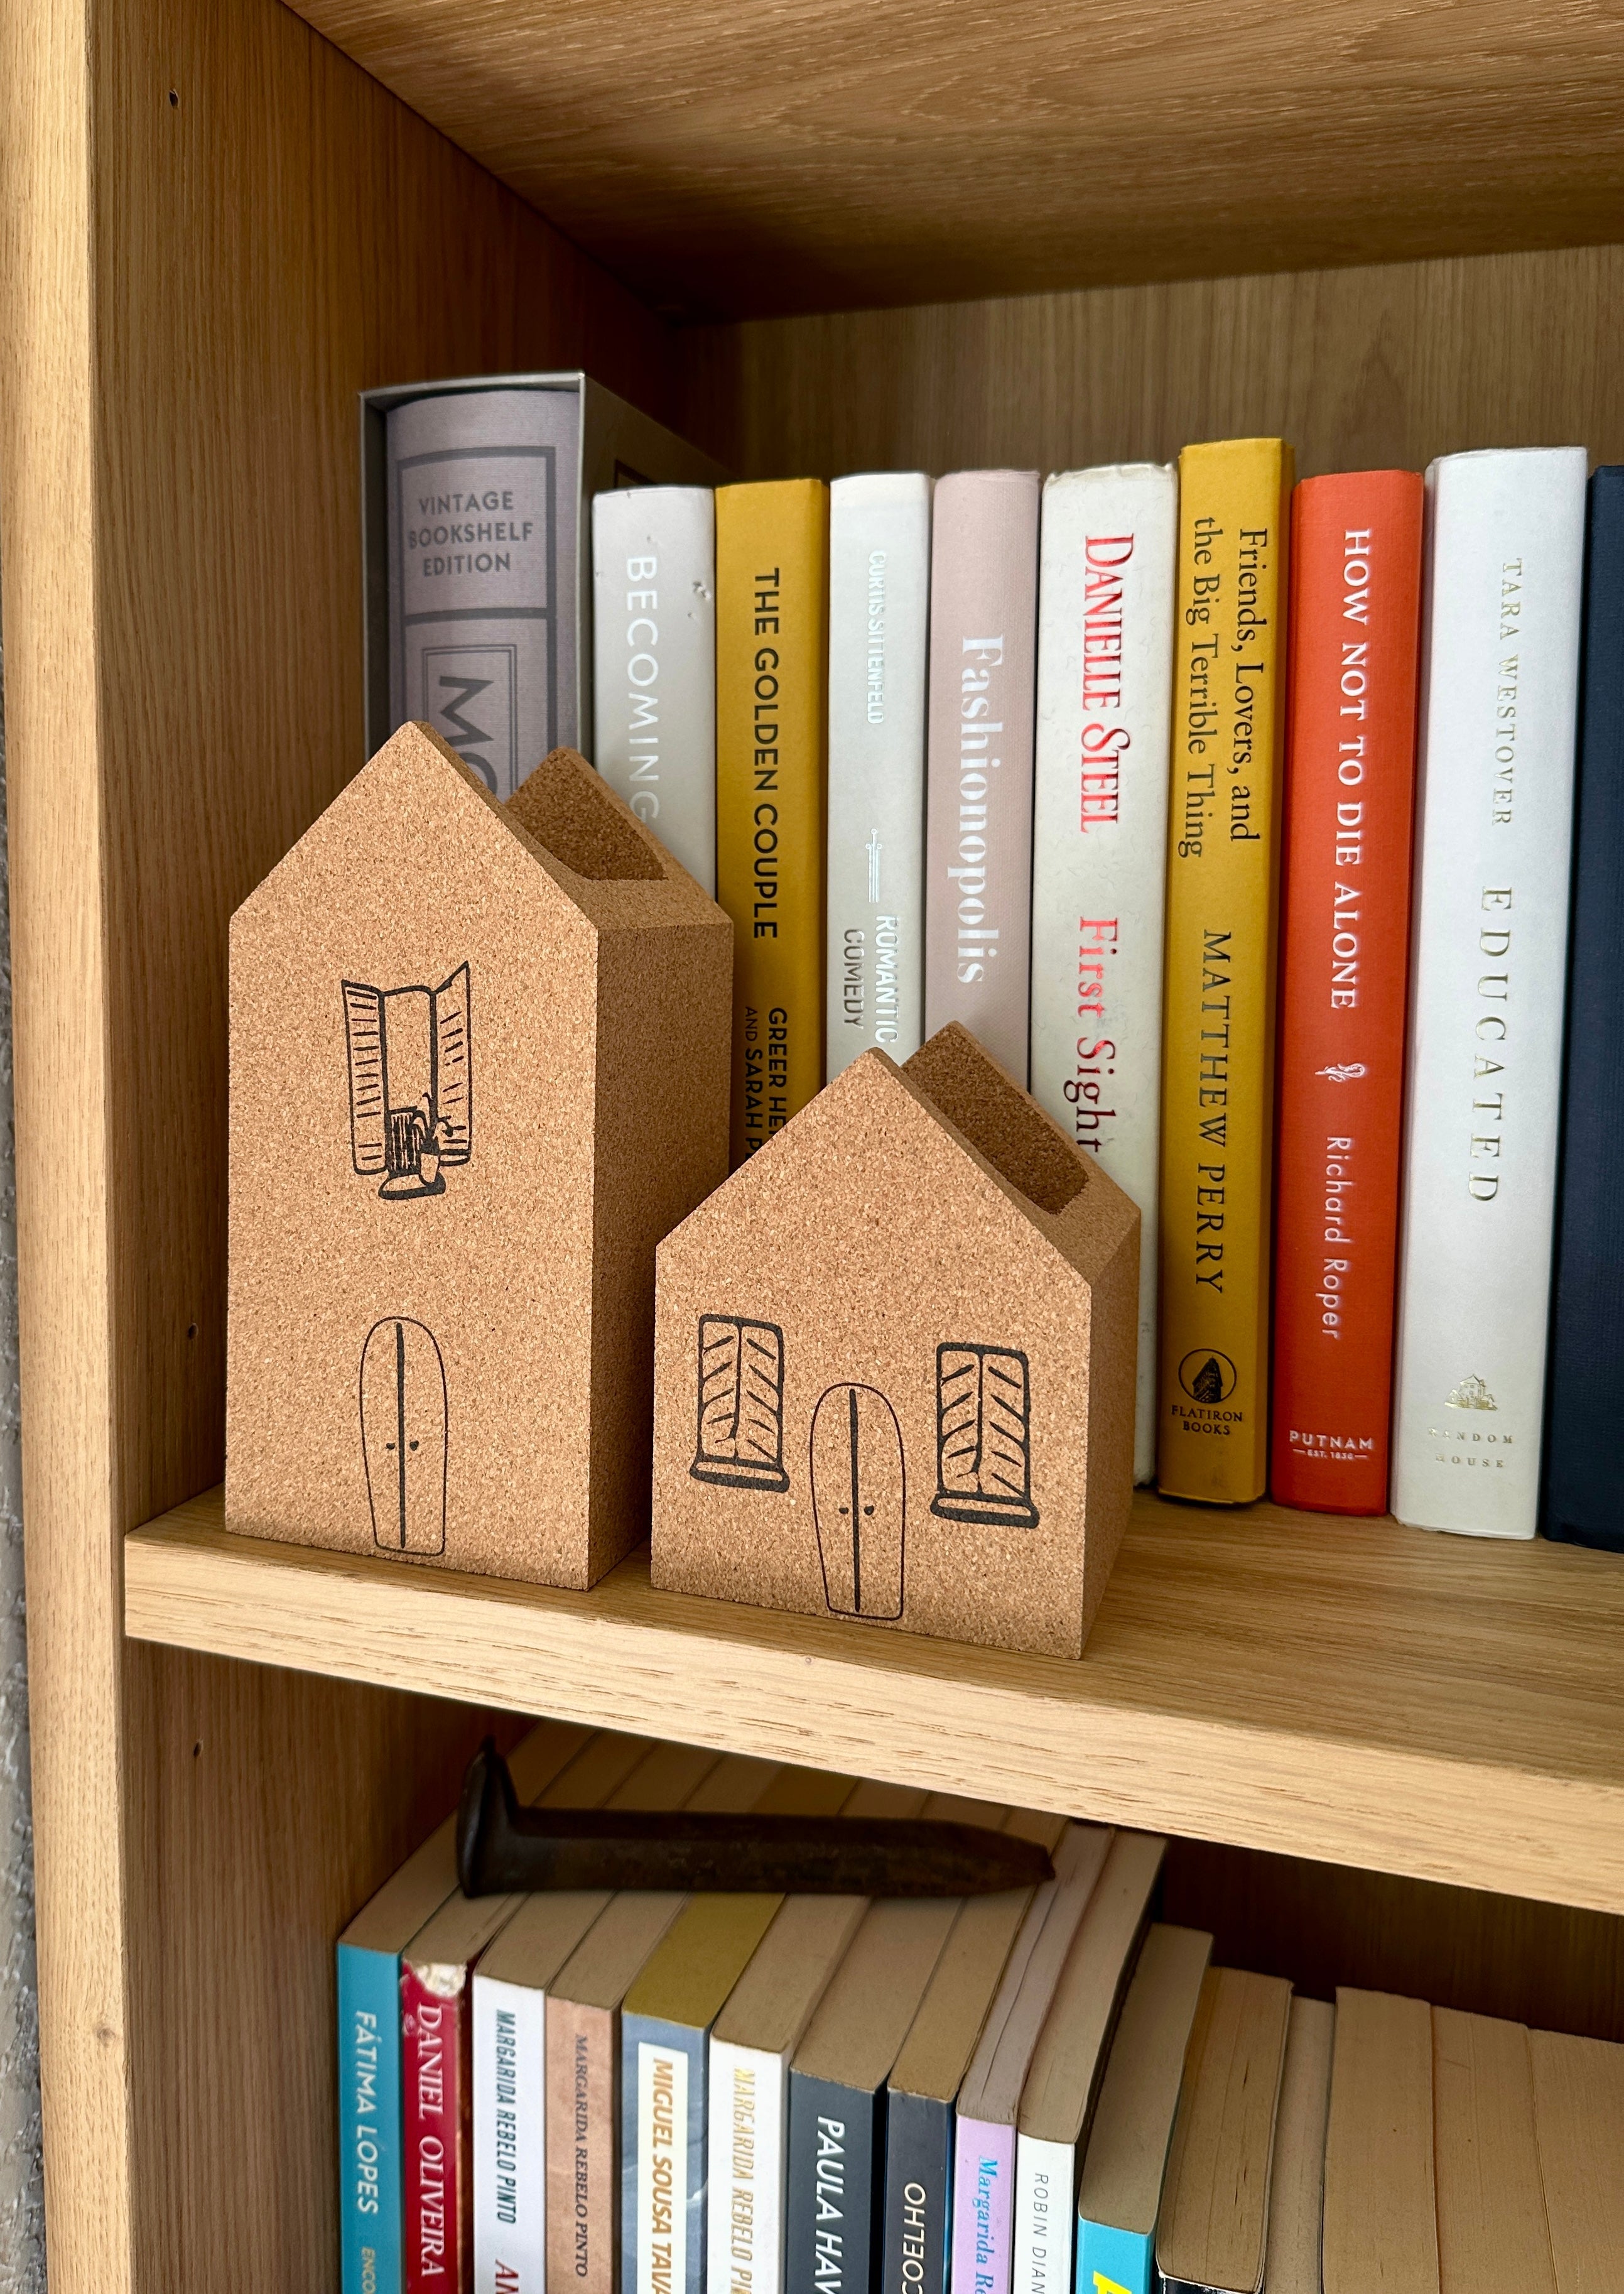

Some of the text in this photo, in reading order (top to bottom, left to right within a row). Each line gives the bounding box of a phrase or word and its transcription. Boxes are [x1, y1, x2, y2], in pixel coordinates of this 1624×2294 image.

[409, 522, 533, 550] BOOKSHELF
[419, 491, 513, 516] VINTAGE
[423, 553, 510, 577] EDITION
[627, 556, 659, 822] BECOMING
[867, 550, 886, 724] CURTIS SITTENFELD
[1080, 533, 1134, 834] DANIELLE STEEL
[1178, 517, 1223, 858] the Big Terrible Thing
[1228, 528, 1268, 842] Friends, Lovers, and
[754, 568, 779, 938] THE GOLDEN COUPLE
[947, 634, 1004, 984] Fashionopolis
[1331, 528, 1370, 1009] HOW NOT TO DIE ALONE
[1468, 557, 1522, 1202] TARA WESTOVER EDUCATED
[745, 1006, 758, 1041] AND
[843, 928, 865, 1029] COMEDY
[875, 915, 900, 1043] ROMANTIC
[1063, 916, 1118, 1153] First Sight
[745, 1048, 763, 1128] SARAH
[768, 1008, 788, 1135] GREER HE
[1196, 929, 1232, 1293] MATTHEW PERRY
[1316, 1136, 1352, 1339] Richard Roper
[1171, 1405, 1243, 1422] FLATIRON
[1183, 1420, 1230, 1435] BOOKS
[1289, 1430, 1372, 1449] PUTNAM
[1428, 1428, 1512, 1443] RANDOM
[1436, 1453, 1503, 1468] HOUSE
[355, 2010, 382, 2214] FÁTIMA LOPES
[417, 2001, 445, 2277] DANIEL OLIVEIRA
[495, 2010, 516, 2224] MARGARIDA REBELO PINTO
[575, 2034, 588, 2277] MARGARIDA REBELO PINTO
[652, 2057, 673, 2149] MIGUEL
[732, 2066, 754, 2180] MARGARIDA
[652, 2154, 672, 2234] SOUSA
[730, 2185, 753, 2261] REBELO
[816, 2116, 845, 2221] PAULA
[972, 2156, 998, 2264] Margarida
[1034, 2173, 1049, 2237] ROBIN
[901, 2182, 926, 2294] COELHO
